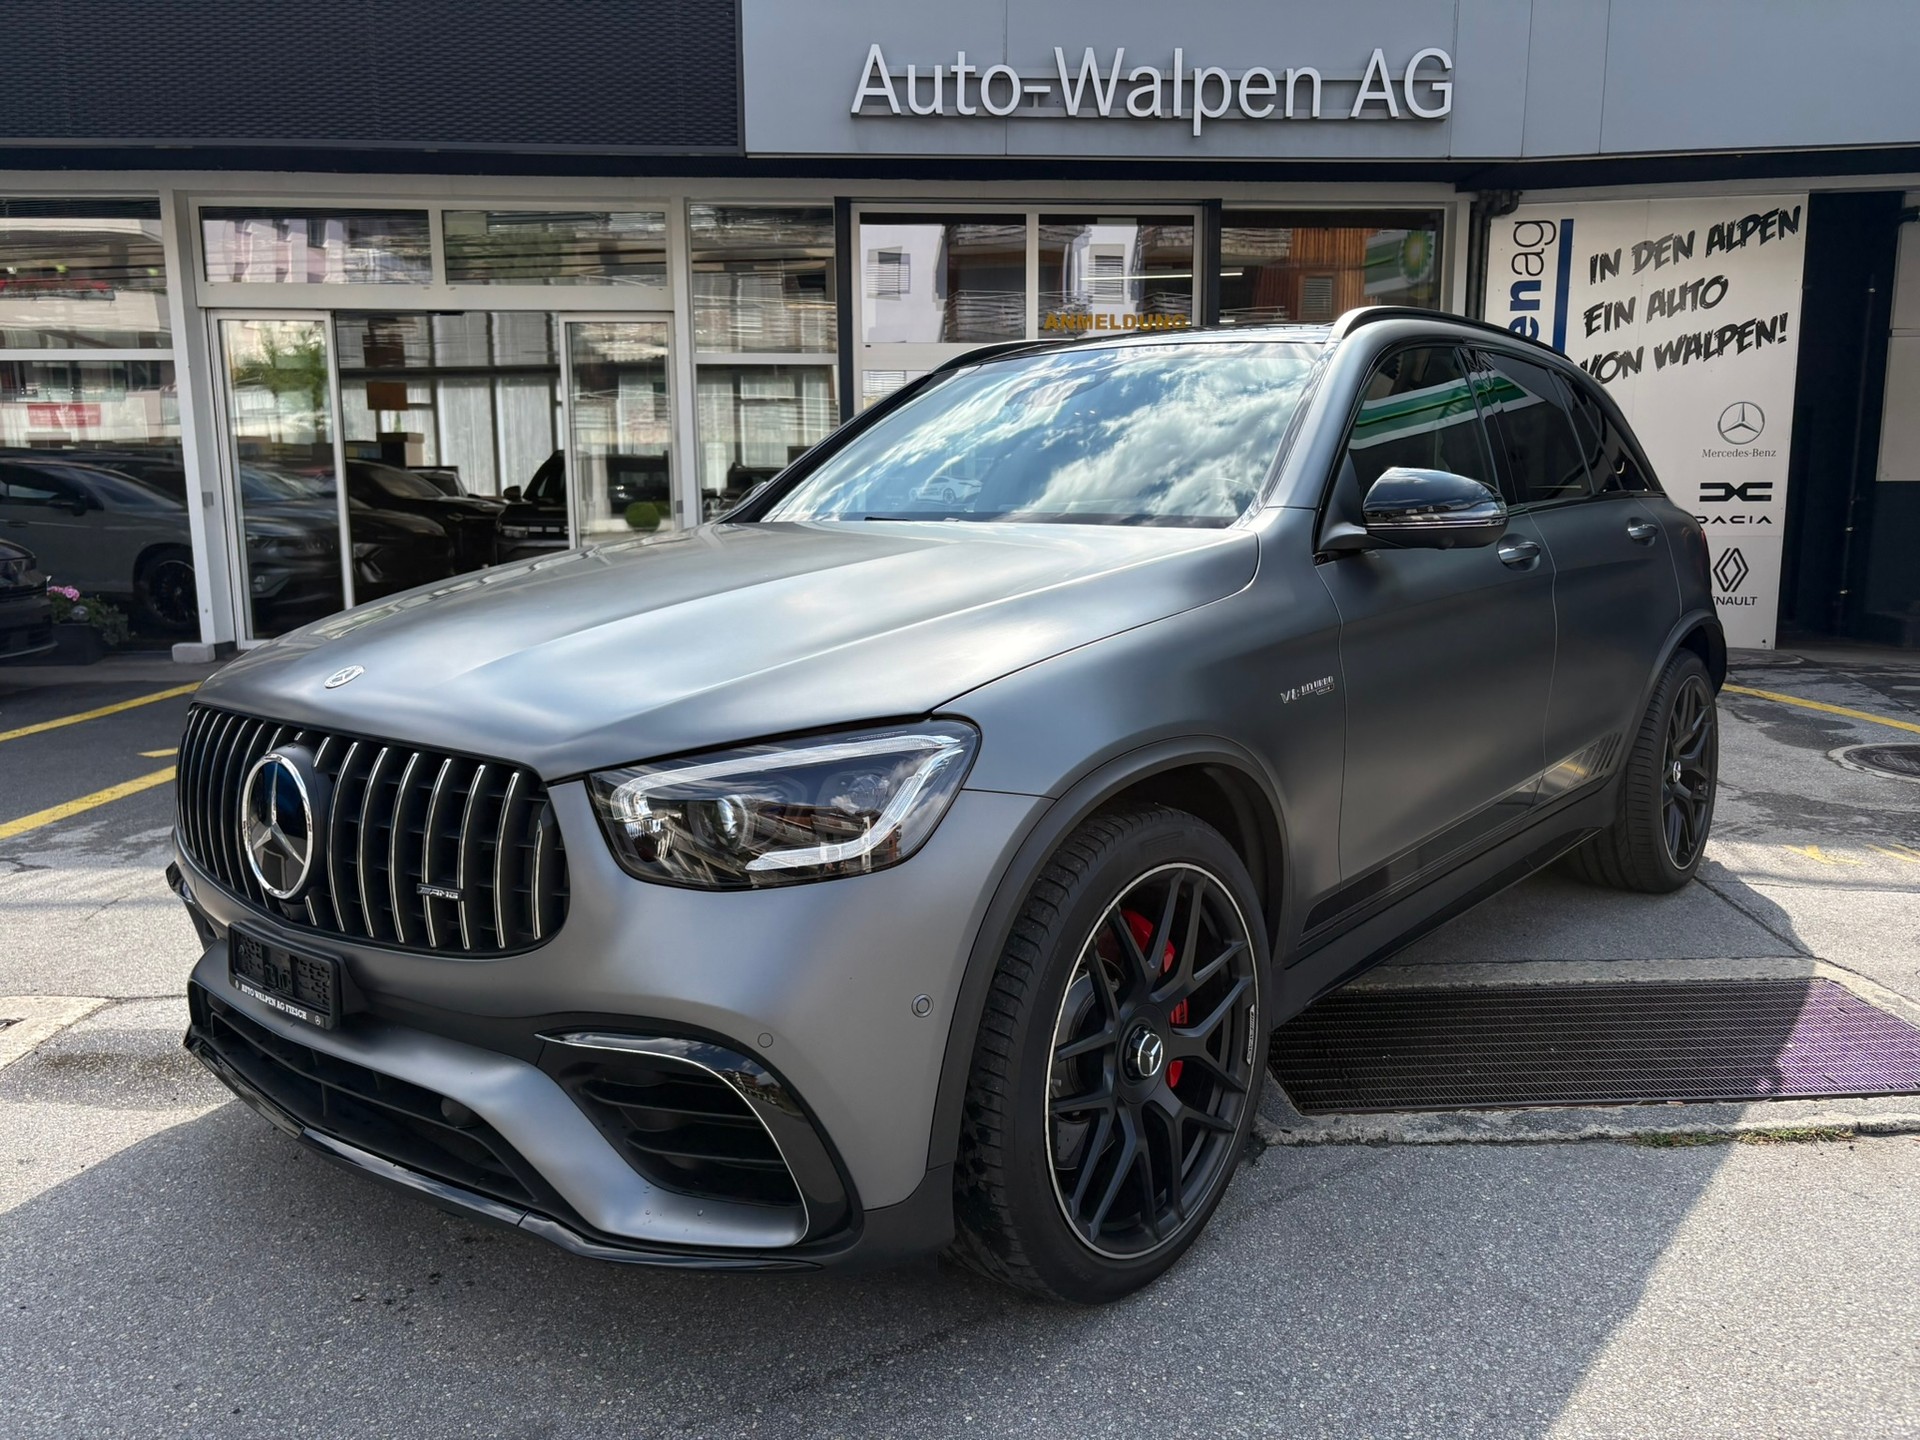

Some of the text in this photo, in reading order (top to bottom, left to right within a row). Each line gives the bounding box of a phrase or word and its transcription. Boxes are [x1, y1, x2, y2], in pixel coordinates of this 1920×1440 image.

[851, 43, 1454, 137] Auto-Walpen AG
[1590, 205, 1801, 285] IN DEN ALPEN
[1508, 219, 1557, 341] enag
[1583, 275, 1729, 338] EIN AUTO
[1043, 313, 1187, 331] ANMELDUNG
[1580, 312, 1788, 384] VON WALPEN!
[1701, 448, 1777, 459] Mercedes-Benz
[1713, 596, 1758, 606] NAULT
[241, 983, 255, 997] AUTO
[254, 990, 276, 1007] WALPEN
[276, 999, 285, 1011] AG
